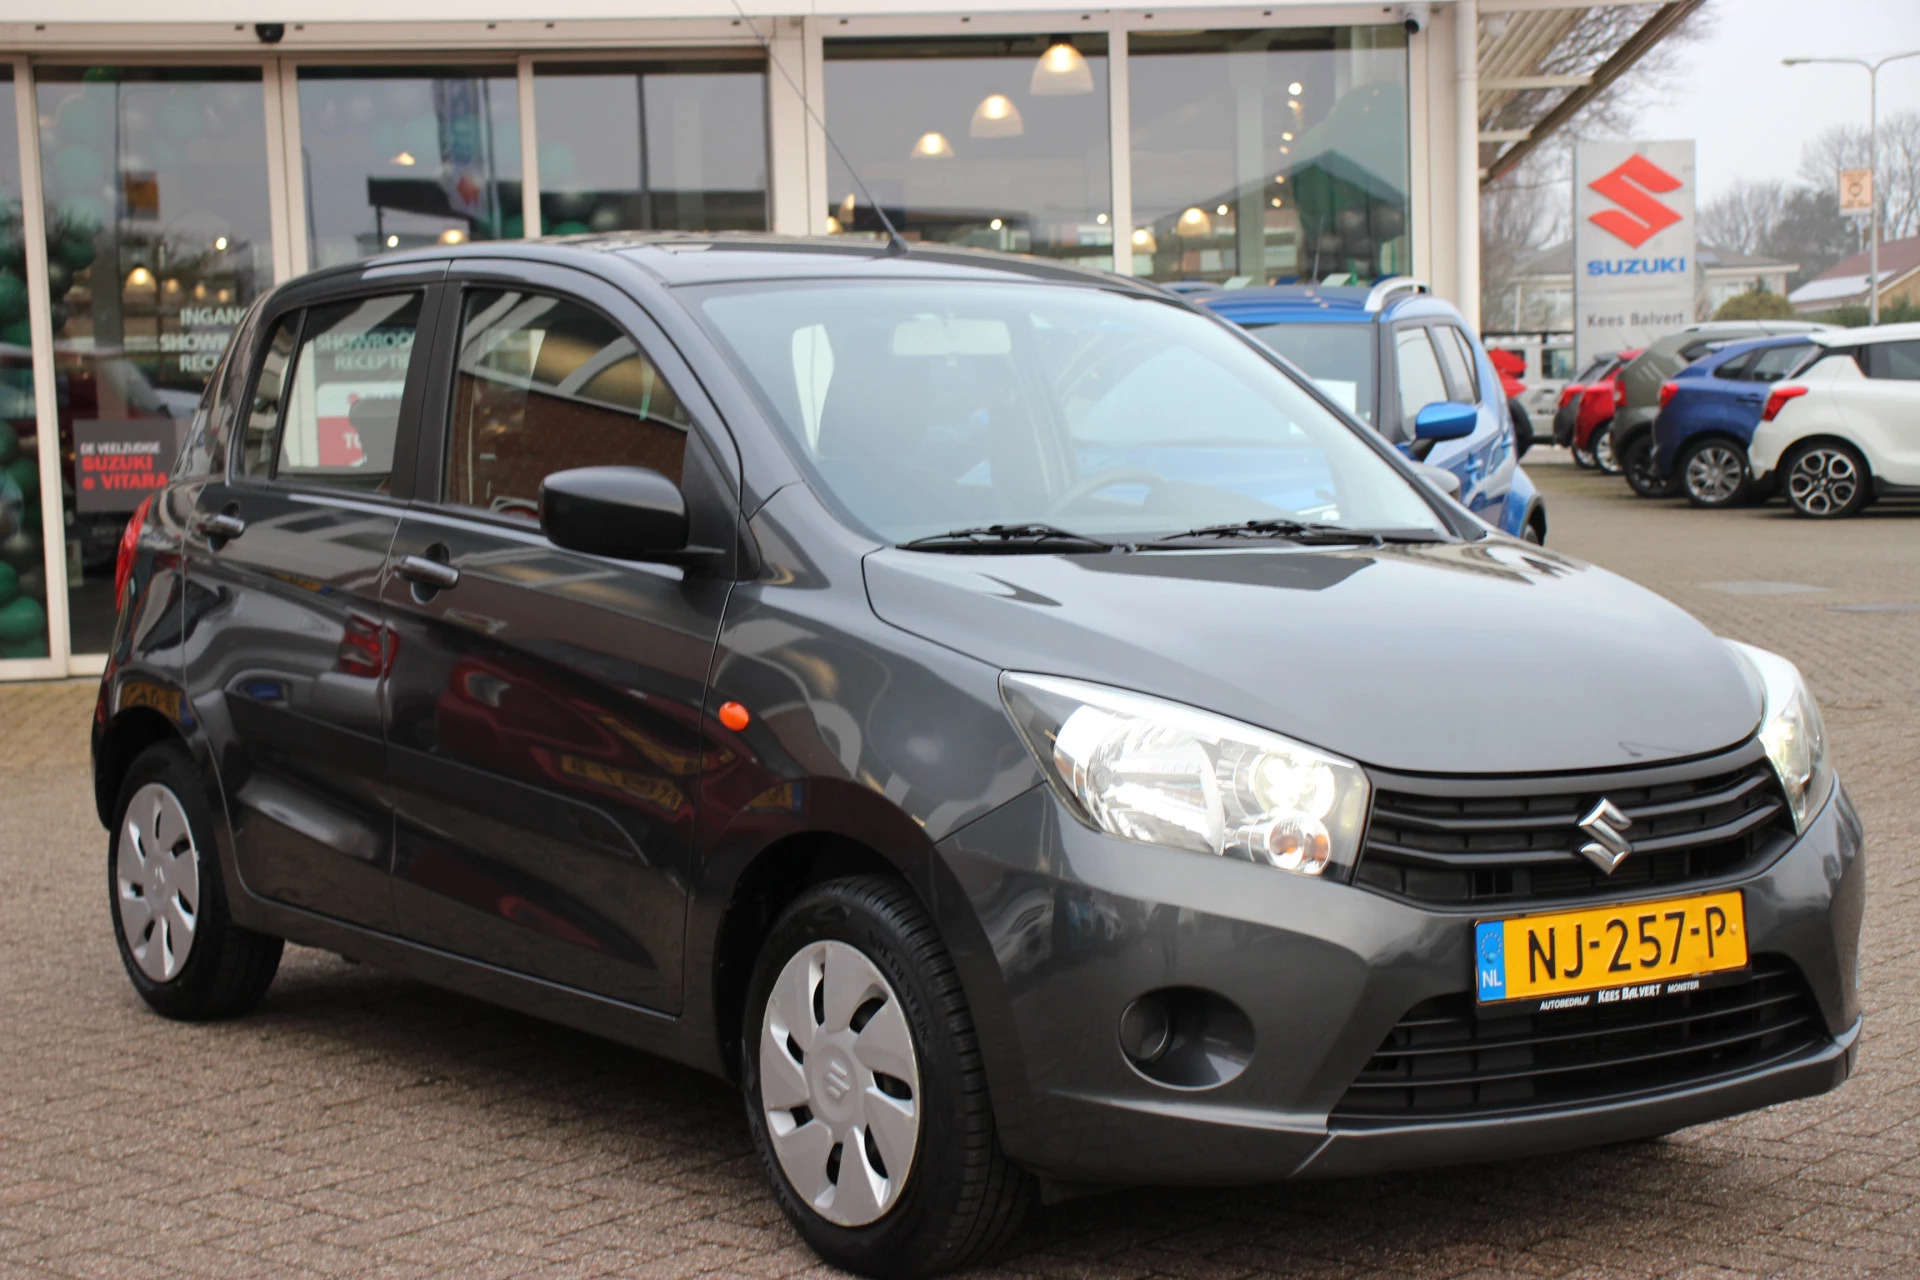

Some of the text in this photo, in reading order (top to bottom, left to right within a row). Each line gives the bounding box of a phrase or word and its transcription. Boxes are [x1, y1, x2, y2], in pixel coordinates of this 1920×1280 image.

[1587, 257, 1686, 276] SUZUKI
[1587, 311, 1683, 327] Kees Balvert
[80, 442, 95, 455] DE
[82, 454, 153, 472] SUZUKI
[101, 472, 169, 490] VITARA
[1528, 906, 1727, 983] NJ-257-P
[1481, 968, 1502, 988] NL
[1540, 995, 1590, 1011] AUTOBEDRIJF
[1622, 983, 1662, 1001] BALVERT
[1667, 979, 1700, 994] MONSTER
